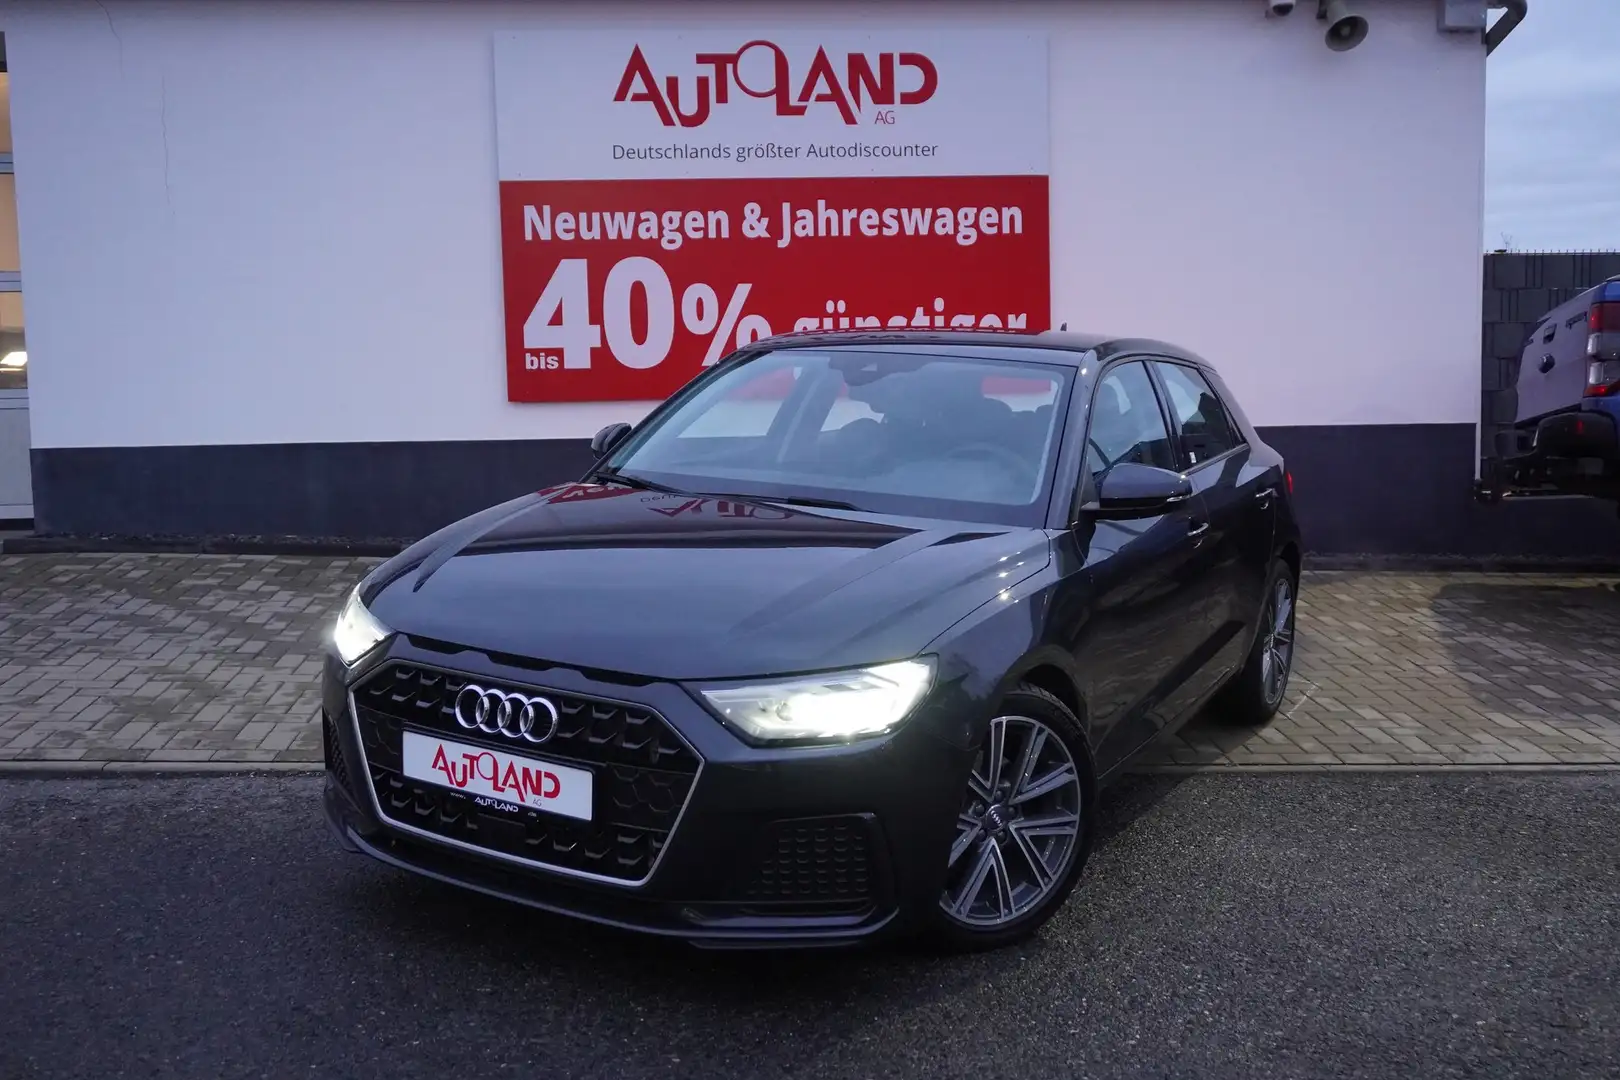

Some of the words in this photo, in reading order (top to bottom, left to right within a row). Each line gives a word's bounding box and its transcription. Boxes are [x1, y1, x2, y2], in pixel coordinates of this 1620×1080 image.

[613, 40, 938, 128] AUTOLAND
[874, 110, 896, 125] AG
[612, 143, 731, 160] Deutschlands
[736, 142, 801, 163] größter
[806, 142, 938, 158] Autodiscounter
[523, 204, 730, 250] Neuwagen
[741, 201, 771, 239] &
[777, 199, 1023, 249] Jahreswagen
[523, 256, 772, 370] 40%
[524, 353, 559, 370] bis
[431, 743, 561, 802] AUTOLAND
